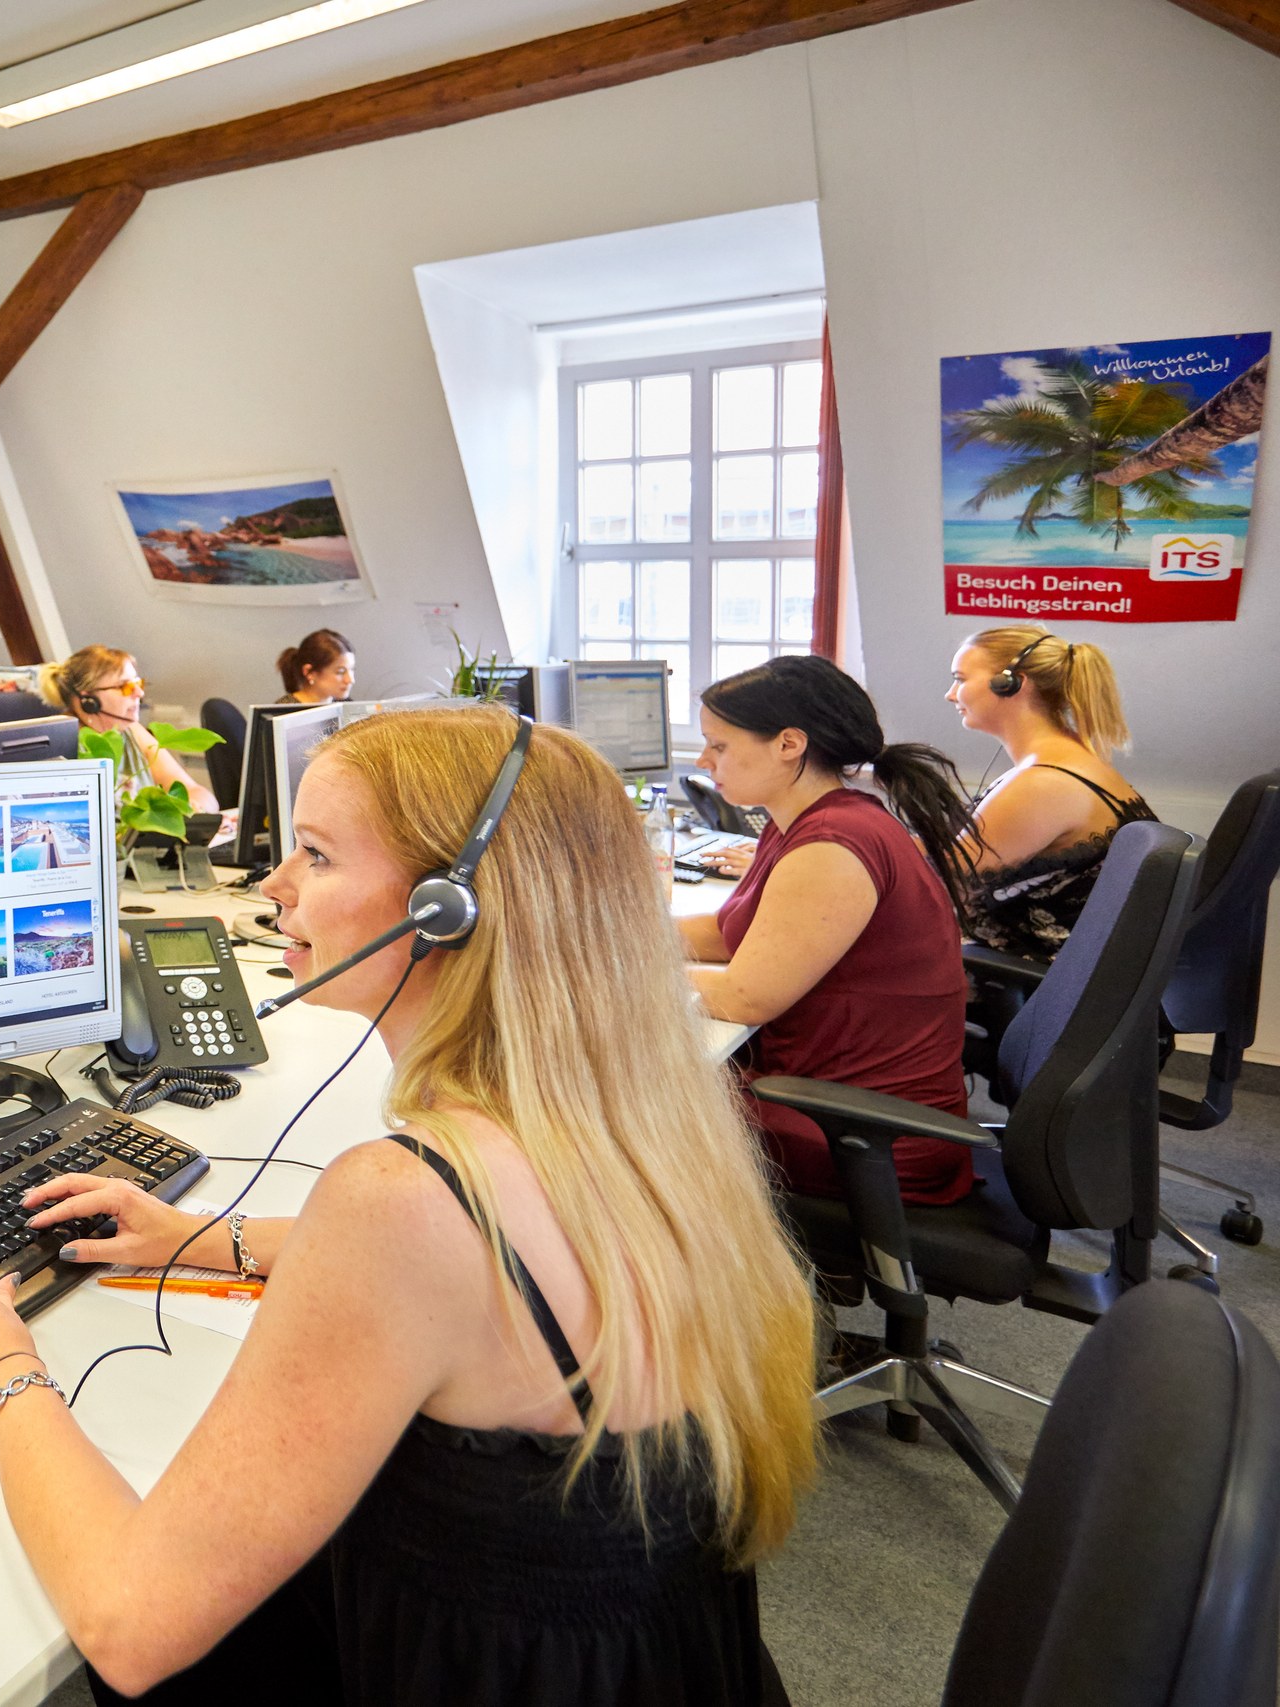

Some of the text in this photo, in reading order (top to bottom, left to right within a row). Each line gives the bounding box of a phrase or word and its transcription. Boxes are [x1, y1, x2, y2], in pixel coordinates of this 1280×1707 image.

[1094, 351, 1209, 375] Willkommen
[1122, 357, 1230, 384] im Urlaub!
[1160, 551, 1220, 569] ITS
[956, 573, 1122, 593] Besuch Deinen
[956, 592, 1132, 614] Lieblingsstrand!
